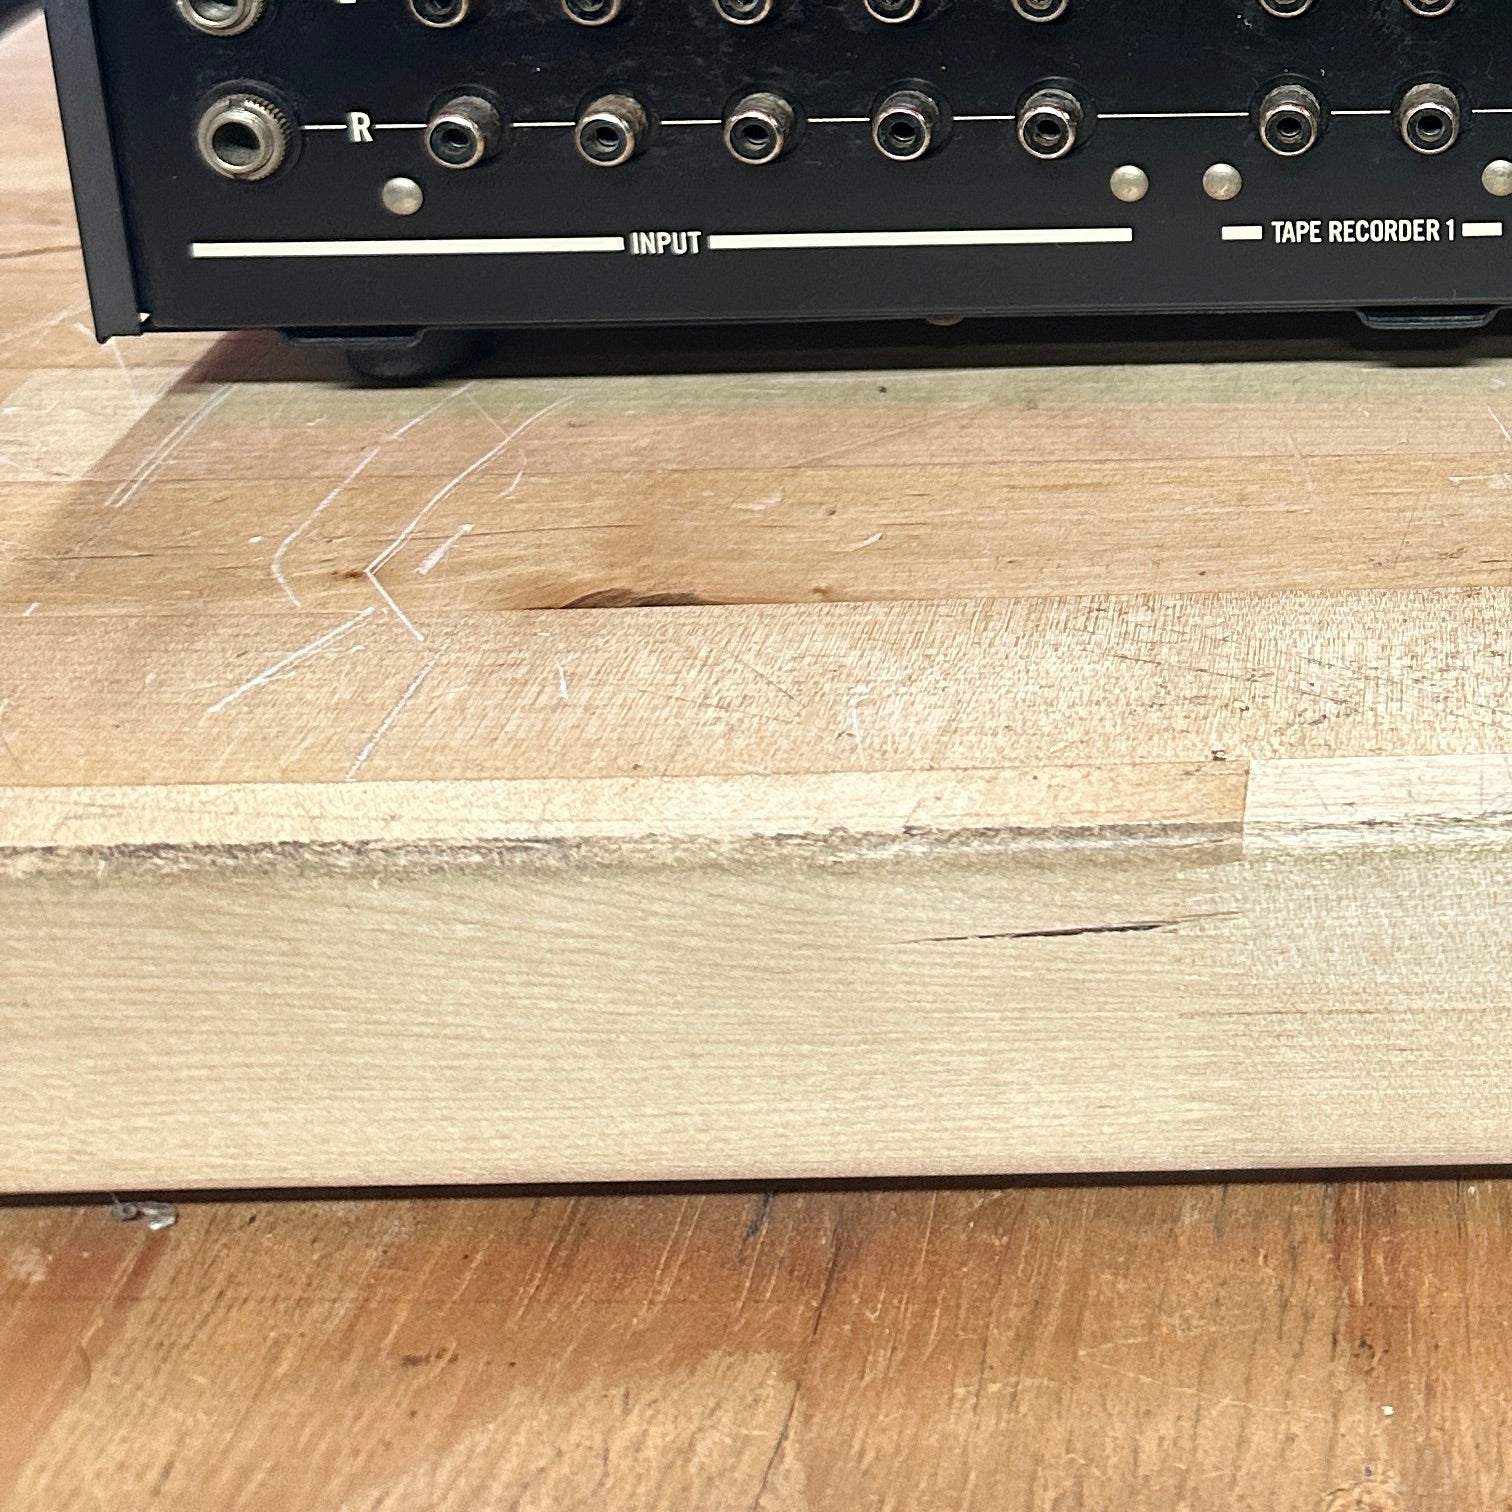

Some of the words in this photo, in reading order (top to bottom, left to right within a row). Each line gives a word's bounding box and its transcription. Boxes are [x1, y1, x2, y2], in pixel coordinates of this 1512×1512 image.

[348, 111, 374, 143] R
[631, 231, 702, 255] INPUT
[1270, 220, 1322, 244] TAPE
[1328, 218, 1440, 243] RECORDER
[1445, 218, 1454, 241] 1
